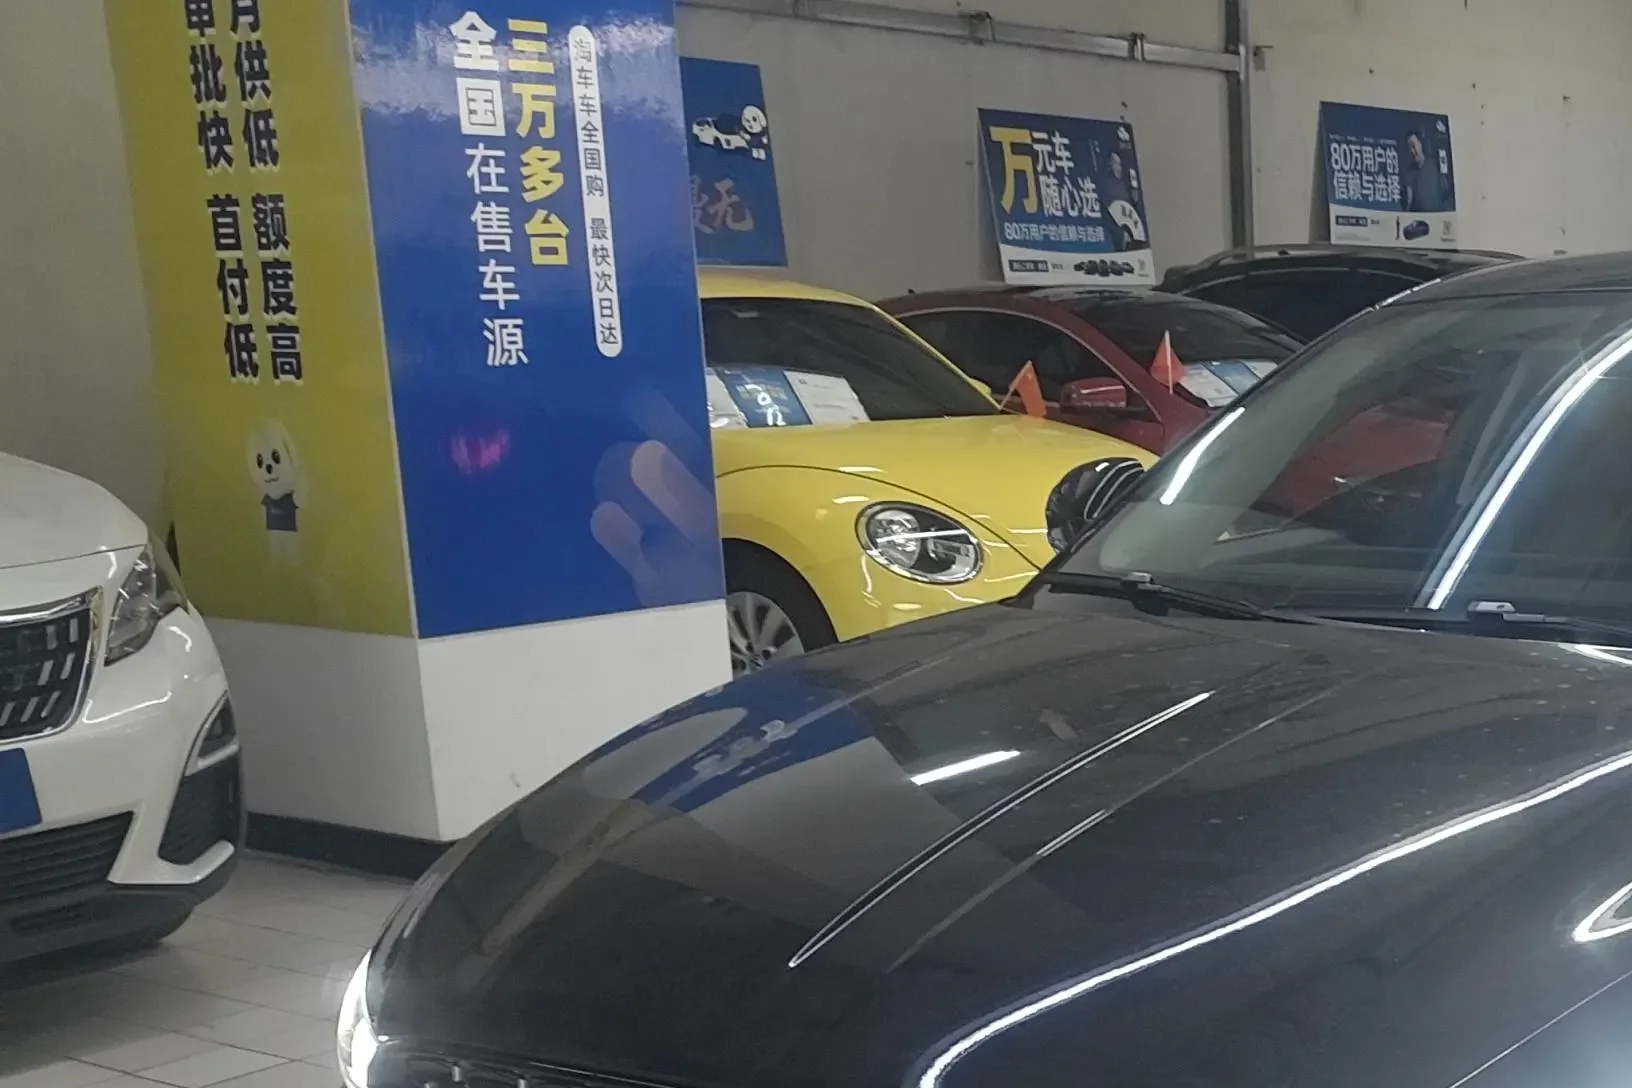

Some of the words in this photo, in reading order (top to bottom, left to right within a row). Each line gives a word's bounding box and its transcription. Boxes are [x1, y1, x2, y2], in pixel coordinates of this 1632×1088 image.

[449, 10, 529, 367] 全国在售车源
[507, 18, 570, 266] 三万多台
[1038, 174, 1102, 218] 随心选
[1330, 142, 1400, 174] 80万用户的
[206, 194, 259, 379] 首付低
[251, 193, 303, 379] 额度高
[590, 217, 618, 345] 最快次日达
